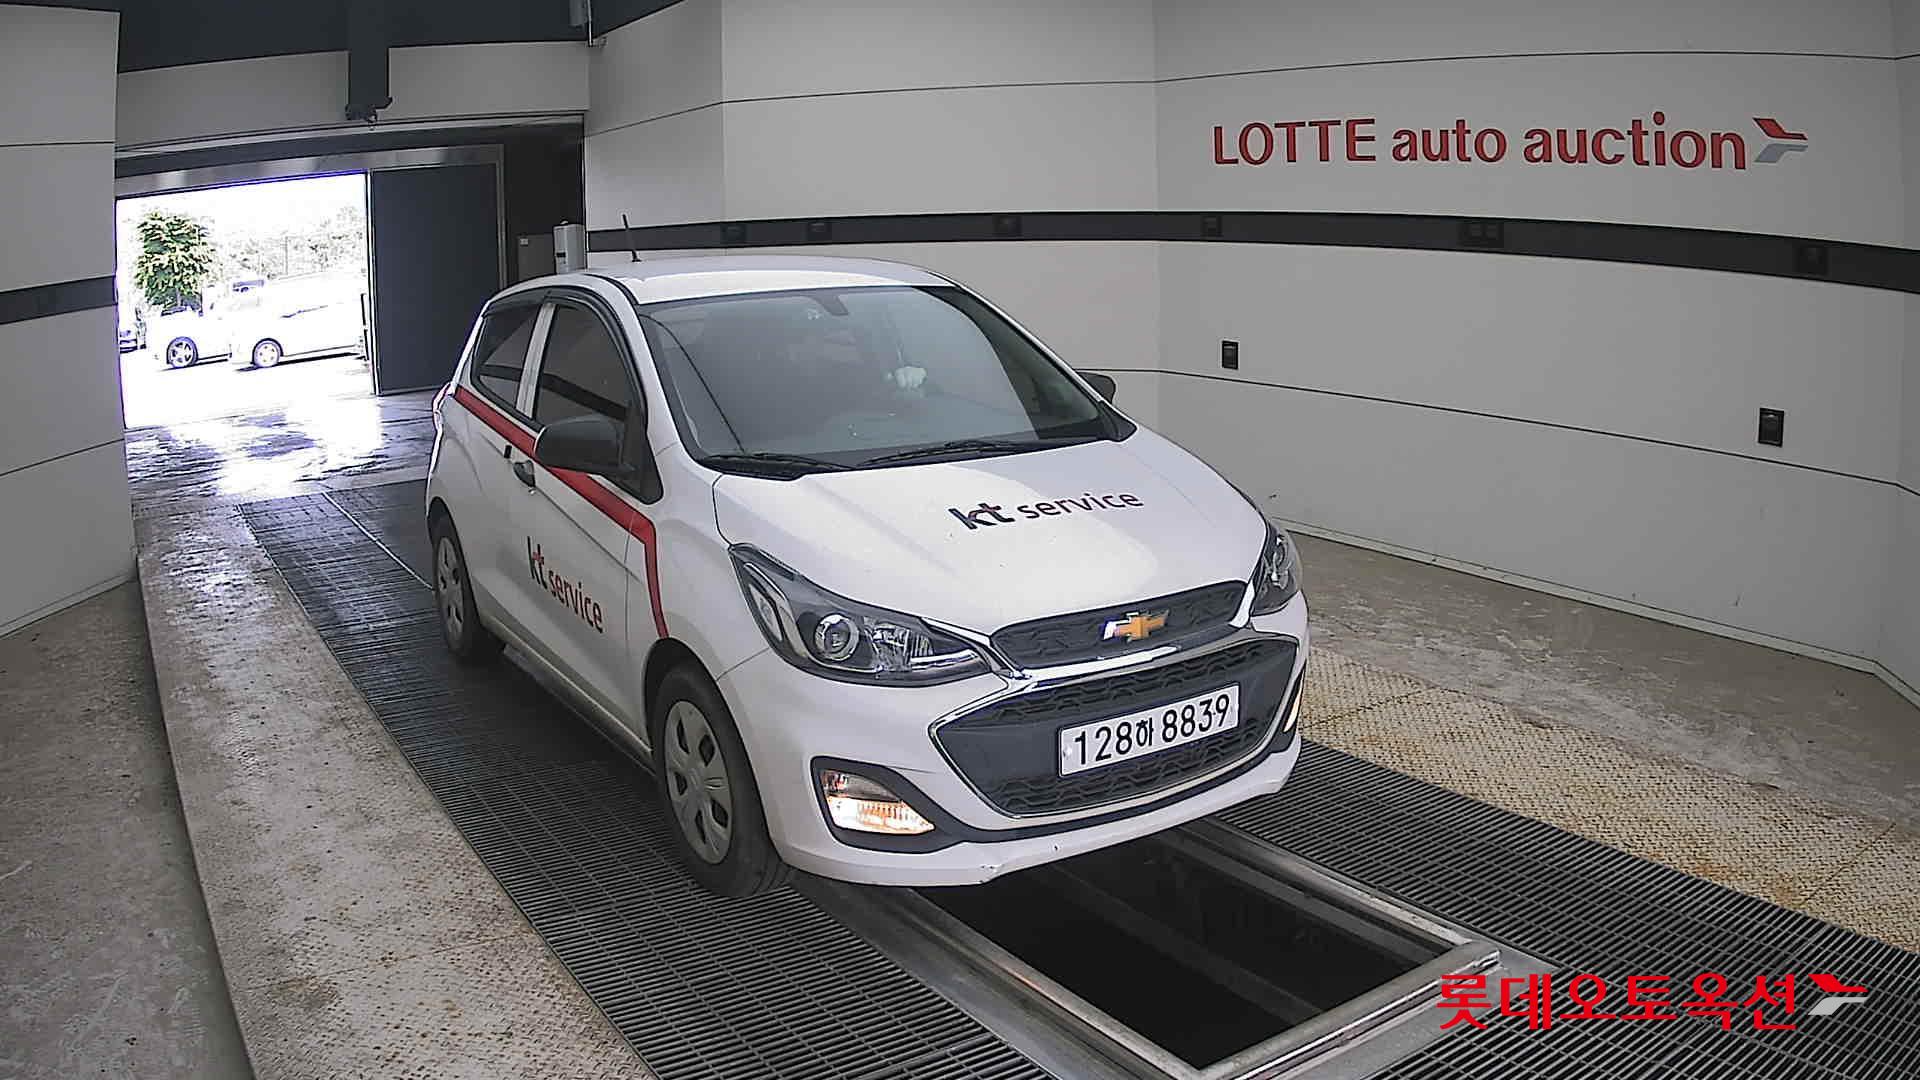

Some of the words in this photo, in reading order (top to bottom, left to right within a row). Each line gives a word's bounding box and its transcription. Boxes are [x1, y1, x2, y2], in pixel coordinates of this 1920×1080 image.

[1213, 118, 1376, 165] LOTTE
[1392, 119, 1507, 163] auto
[1523, 111, 1746, 170] auction
[948, 502, 1016, 530] kt
[1017, 493, 1144, 519] service
[527, 535, 548, 590] kt
[548, 570, 603, 634] service
[1074, 717, 1154, 765] 128하
[1162, 694, 1230, 743] 8839
